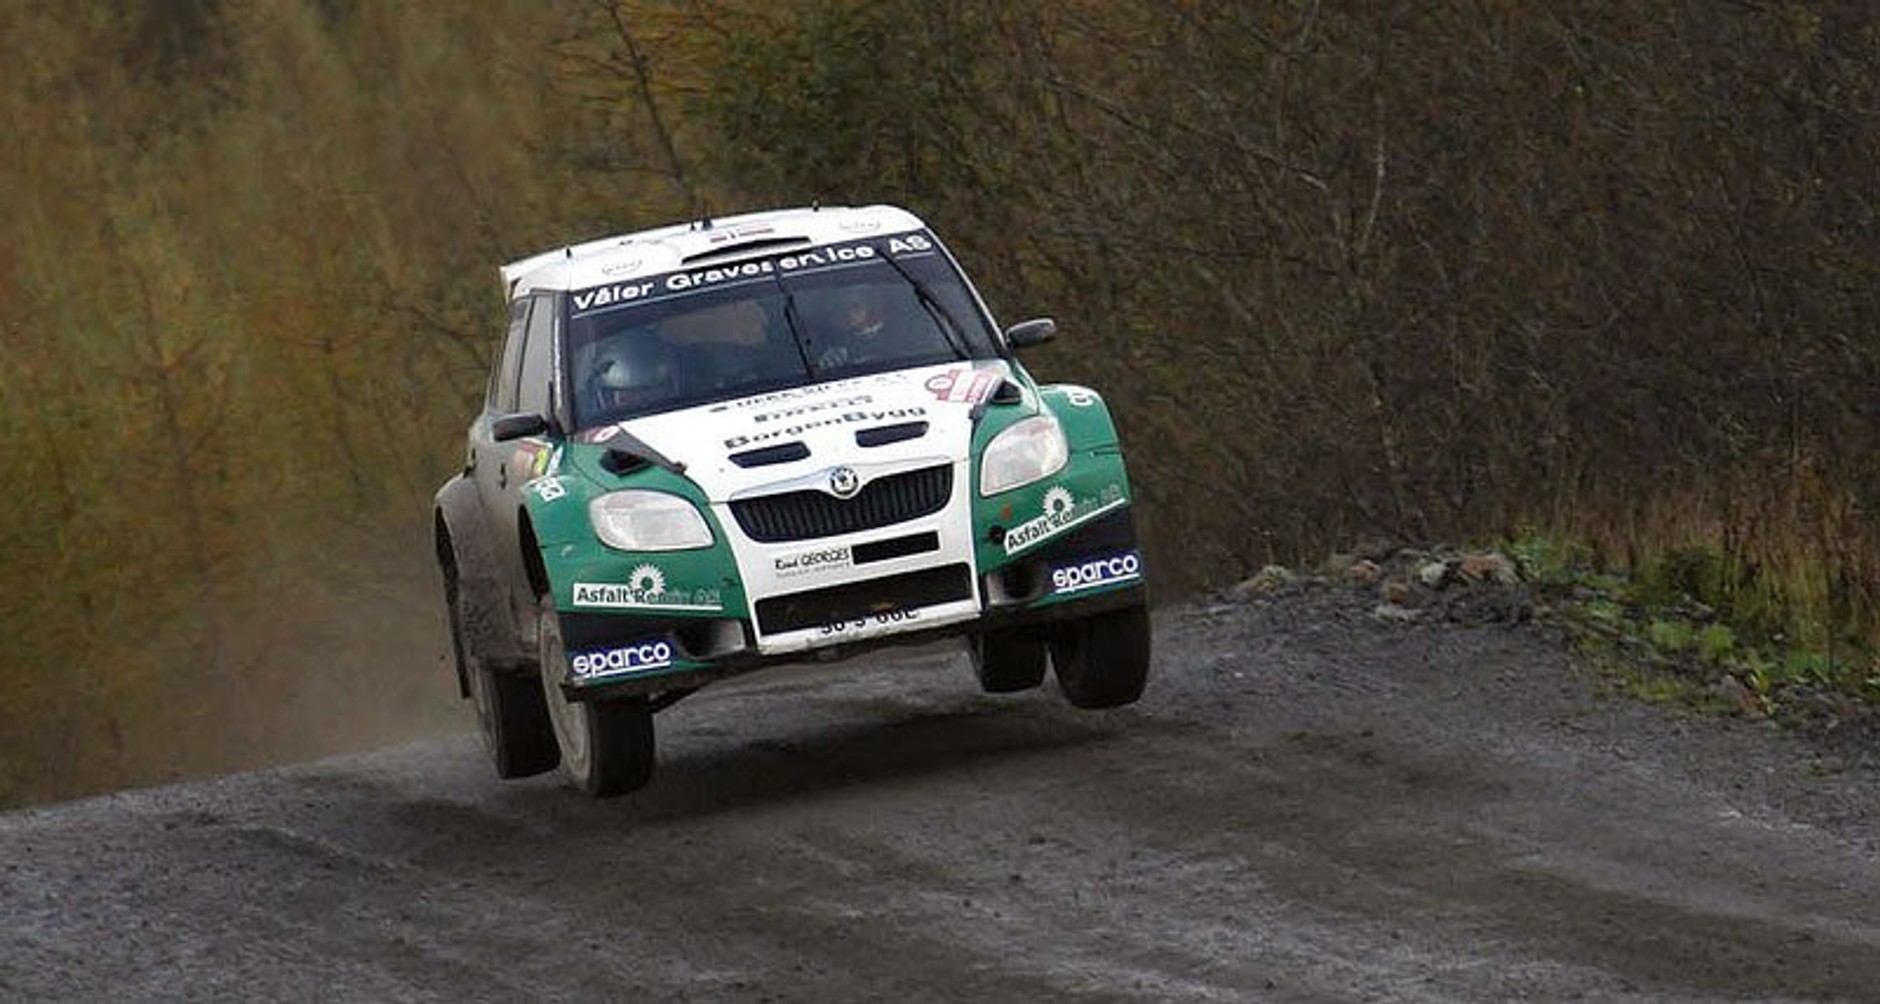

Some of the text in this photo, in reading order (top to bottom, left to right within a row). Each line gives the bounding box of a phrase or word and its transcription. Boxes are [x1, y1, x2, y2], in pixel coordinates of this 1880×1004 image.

[573, 282, 654, 310] Våler
[888, 234, 932, 254] AS
[1008, 518, 1051, 550] Asfalt
[1052, 554, 1138, 592] sparco
[576, 587, 629, 603] Asfalt
[572, 642, 670, 679] sparco
